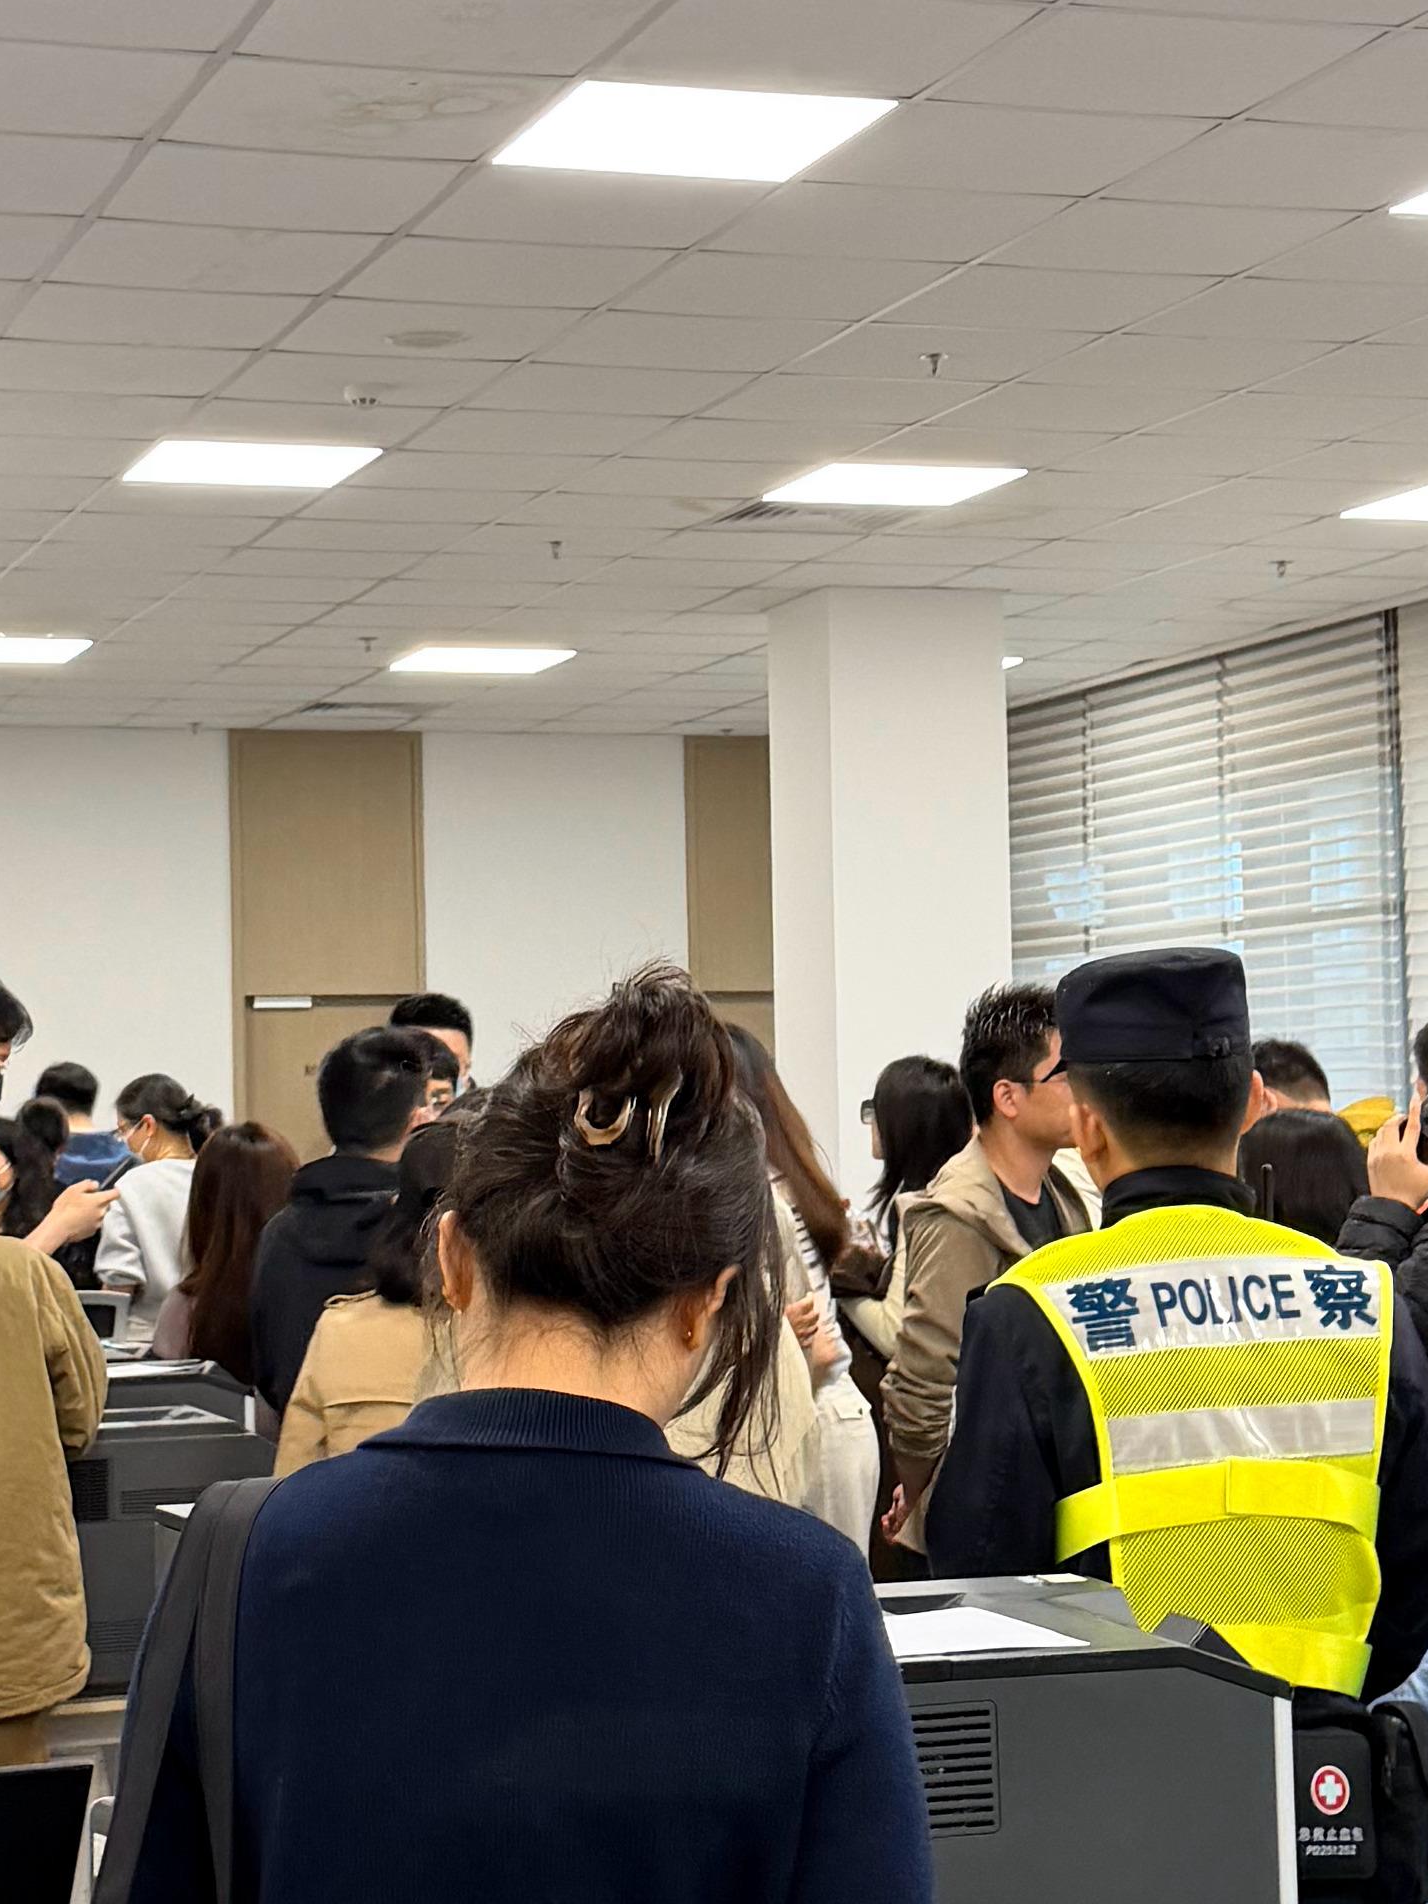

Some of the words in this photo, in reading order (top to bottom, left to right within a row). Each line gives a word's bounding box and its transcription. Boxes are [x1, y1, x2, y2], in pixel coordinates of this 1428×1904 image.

[1066, 1278, 1139, 1352] 警
[1150, 1274, 1301, 1328] POLICE
[1304, 1265, 1378, 1330] 察
